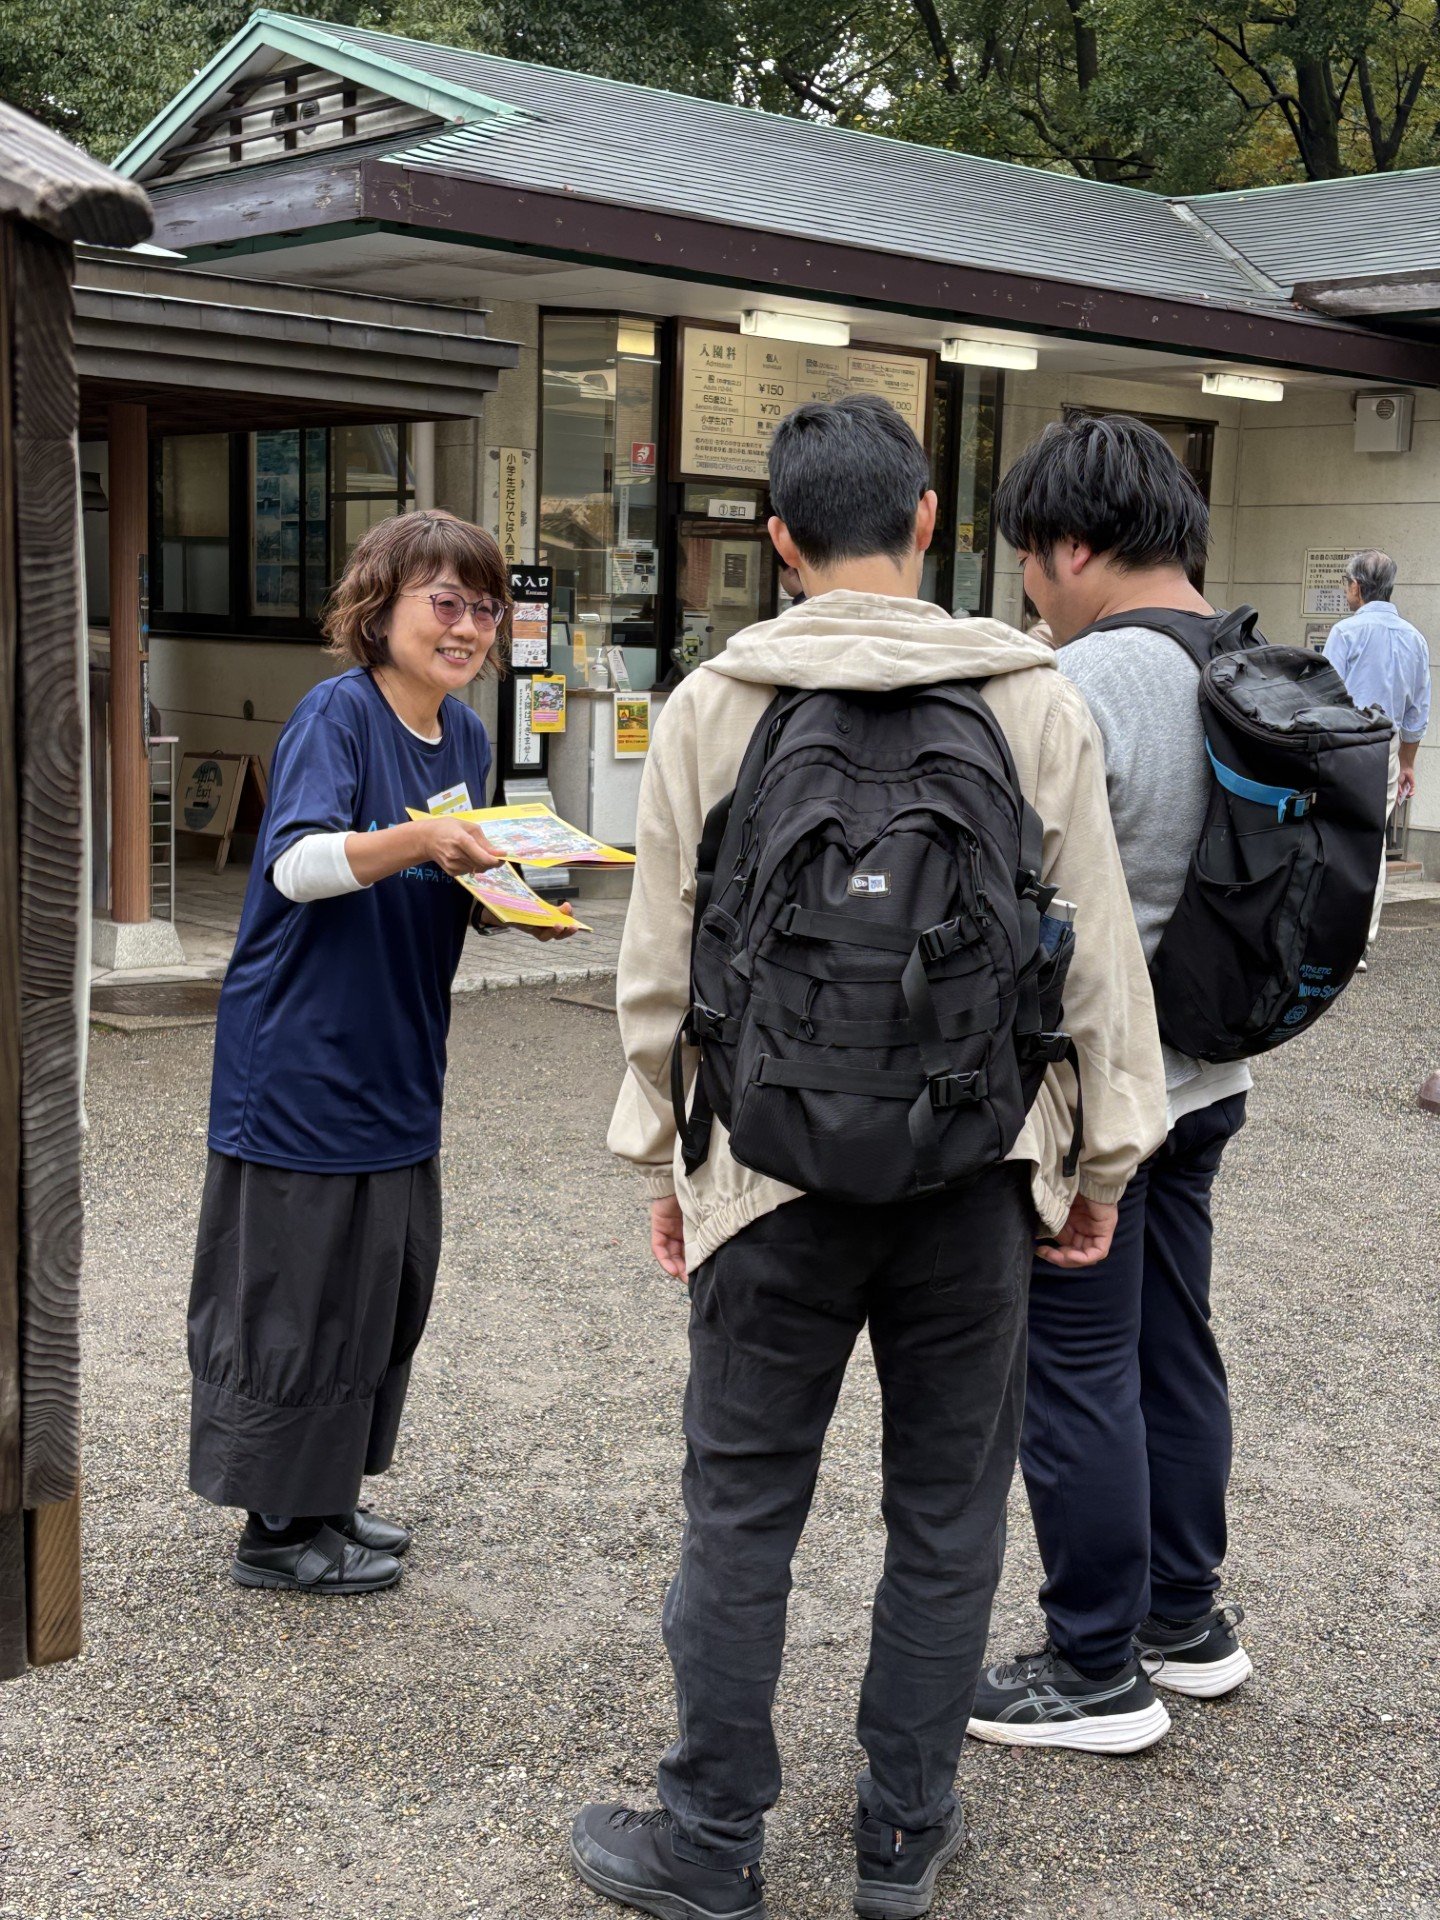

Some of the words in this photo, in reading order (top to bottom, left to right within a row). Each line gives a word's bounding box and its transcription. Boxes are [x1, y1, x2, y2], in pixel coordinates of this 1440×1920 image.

[699, 343, 737, 361] 入園料
[758, 383, 784, 396] ¥150
[760, 403, 781, 416] ¥70
[524, 575, 549, 589] 入口
